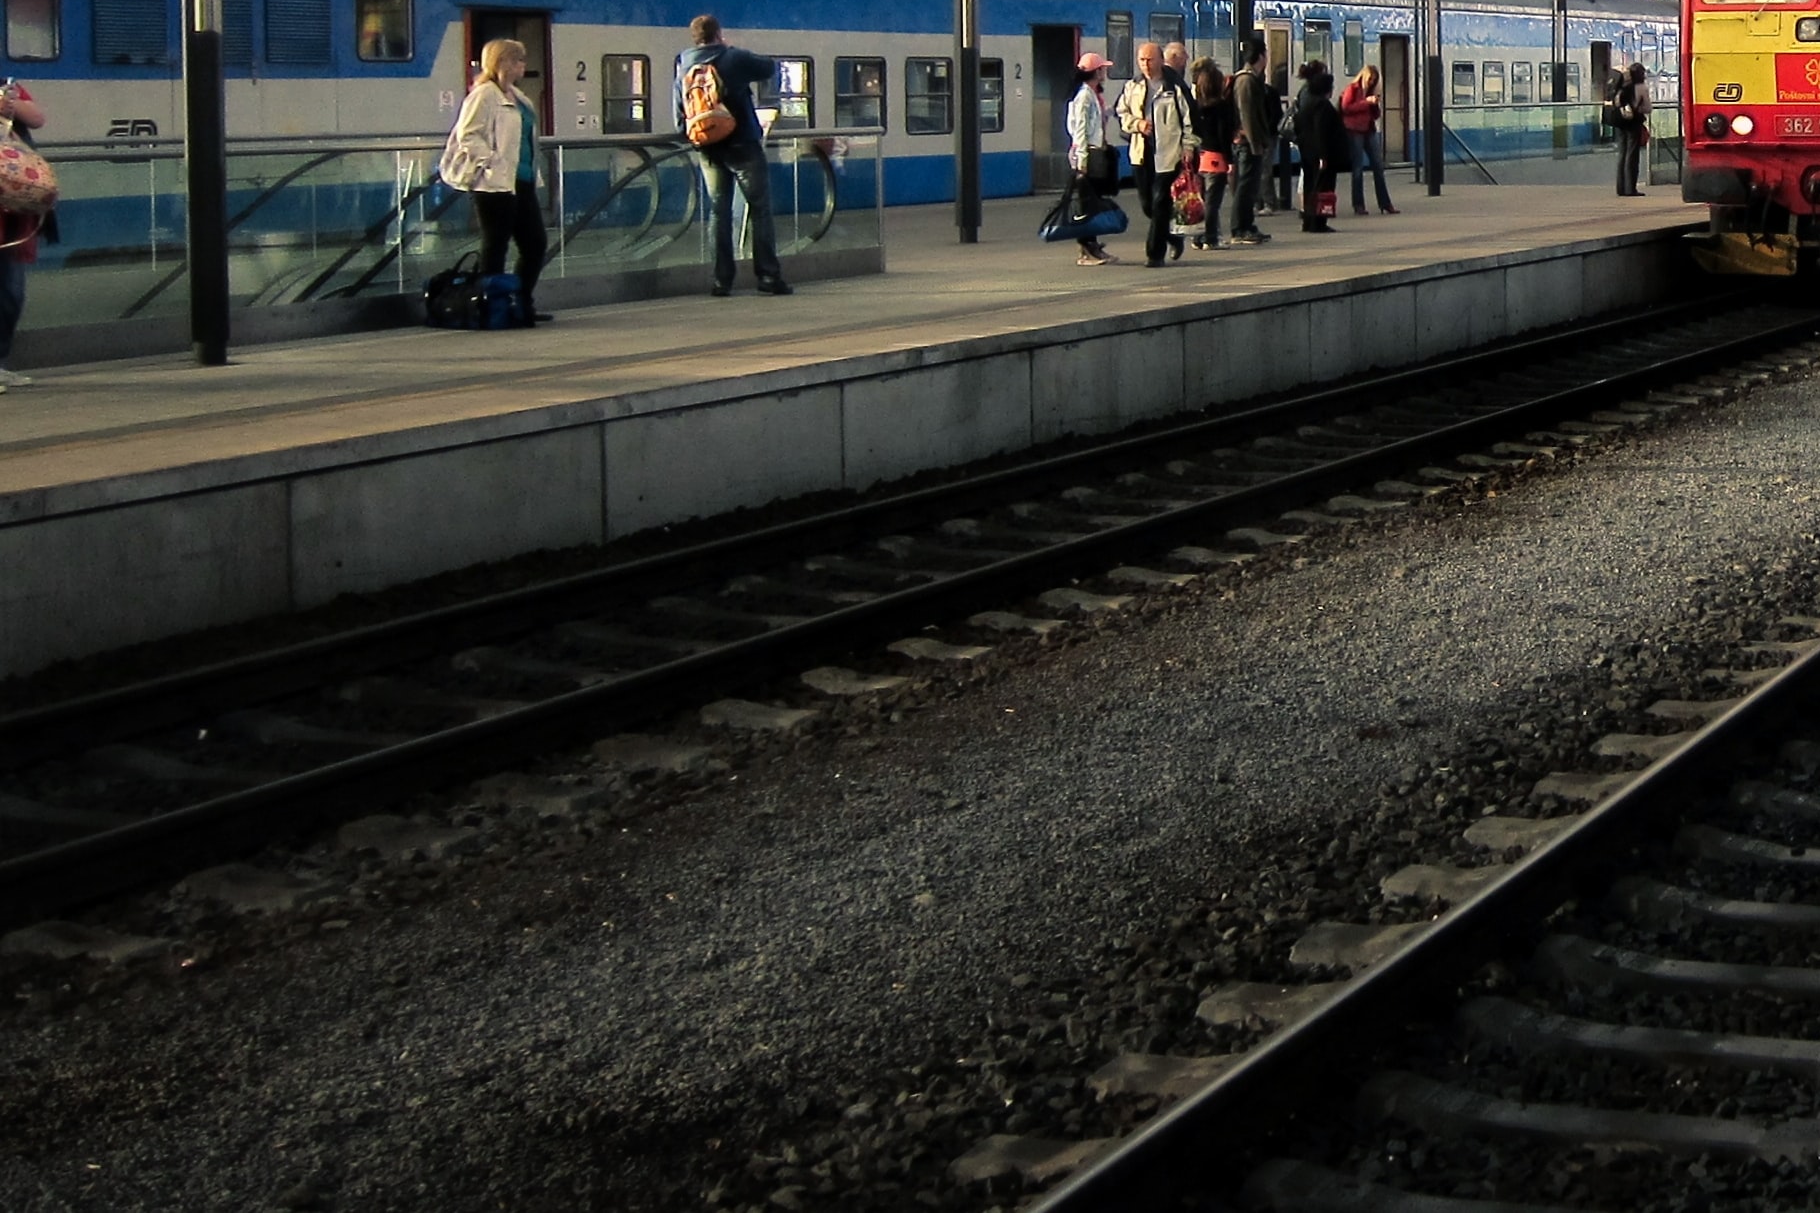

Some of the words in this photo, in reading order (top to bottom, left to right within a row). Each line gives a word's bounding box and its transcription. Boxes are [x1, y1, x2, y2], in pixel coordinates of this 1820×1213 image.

[576, 60, 587, 81] 2
[1014, 62, 1022, 79] 2
[1780, 90, 1816, 100] Poštovní
[1784, 117, 1813, 133] 362
